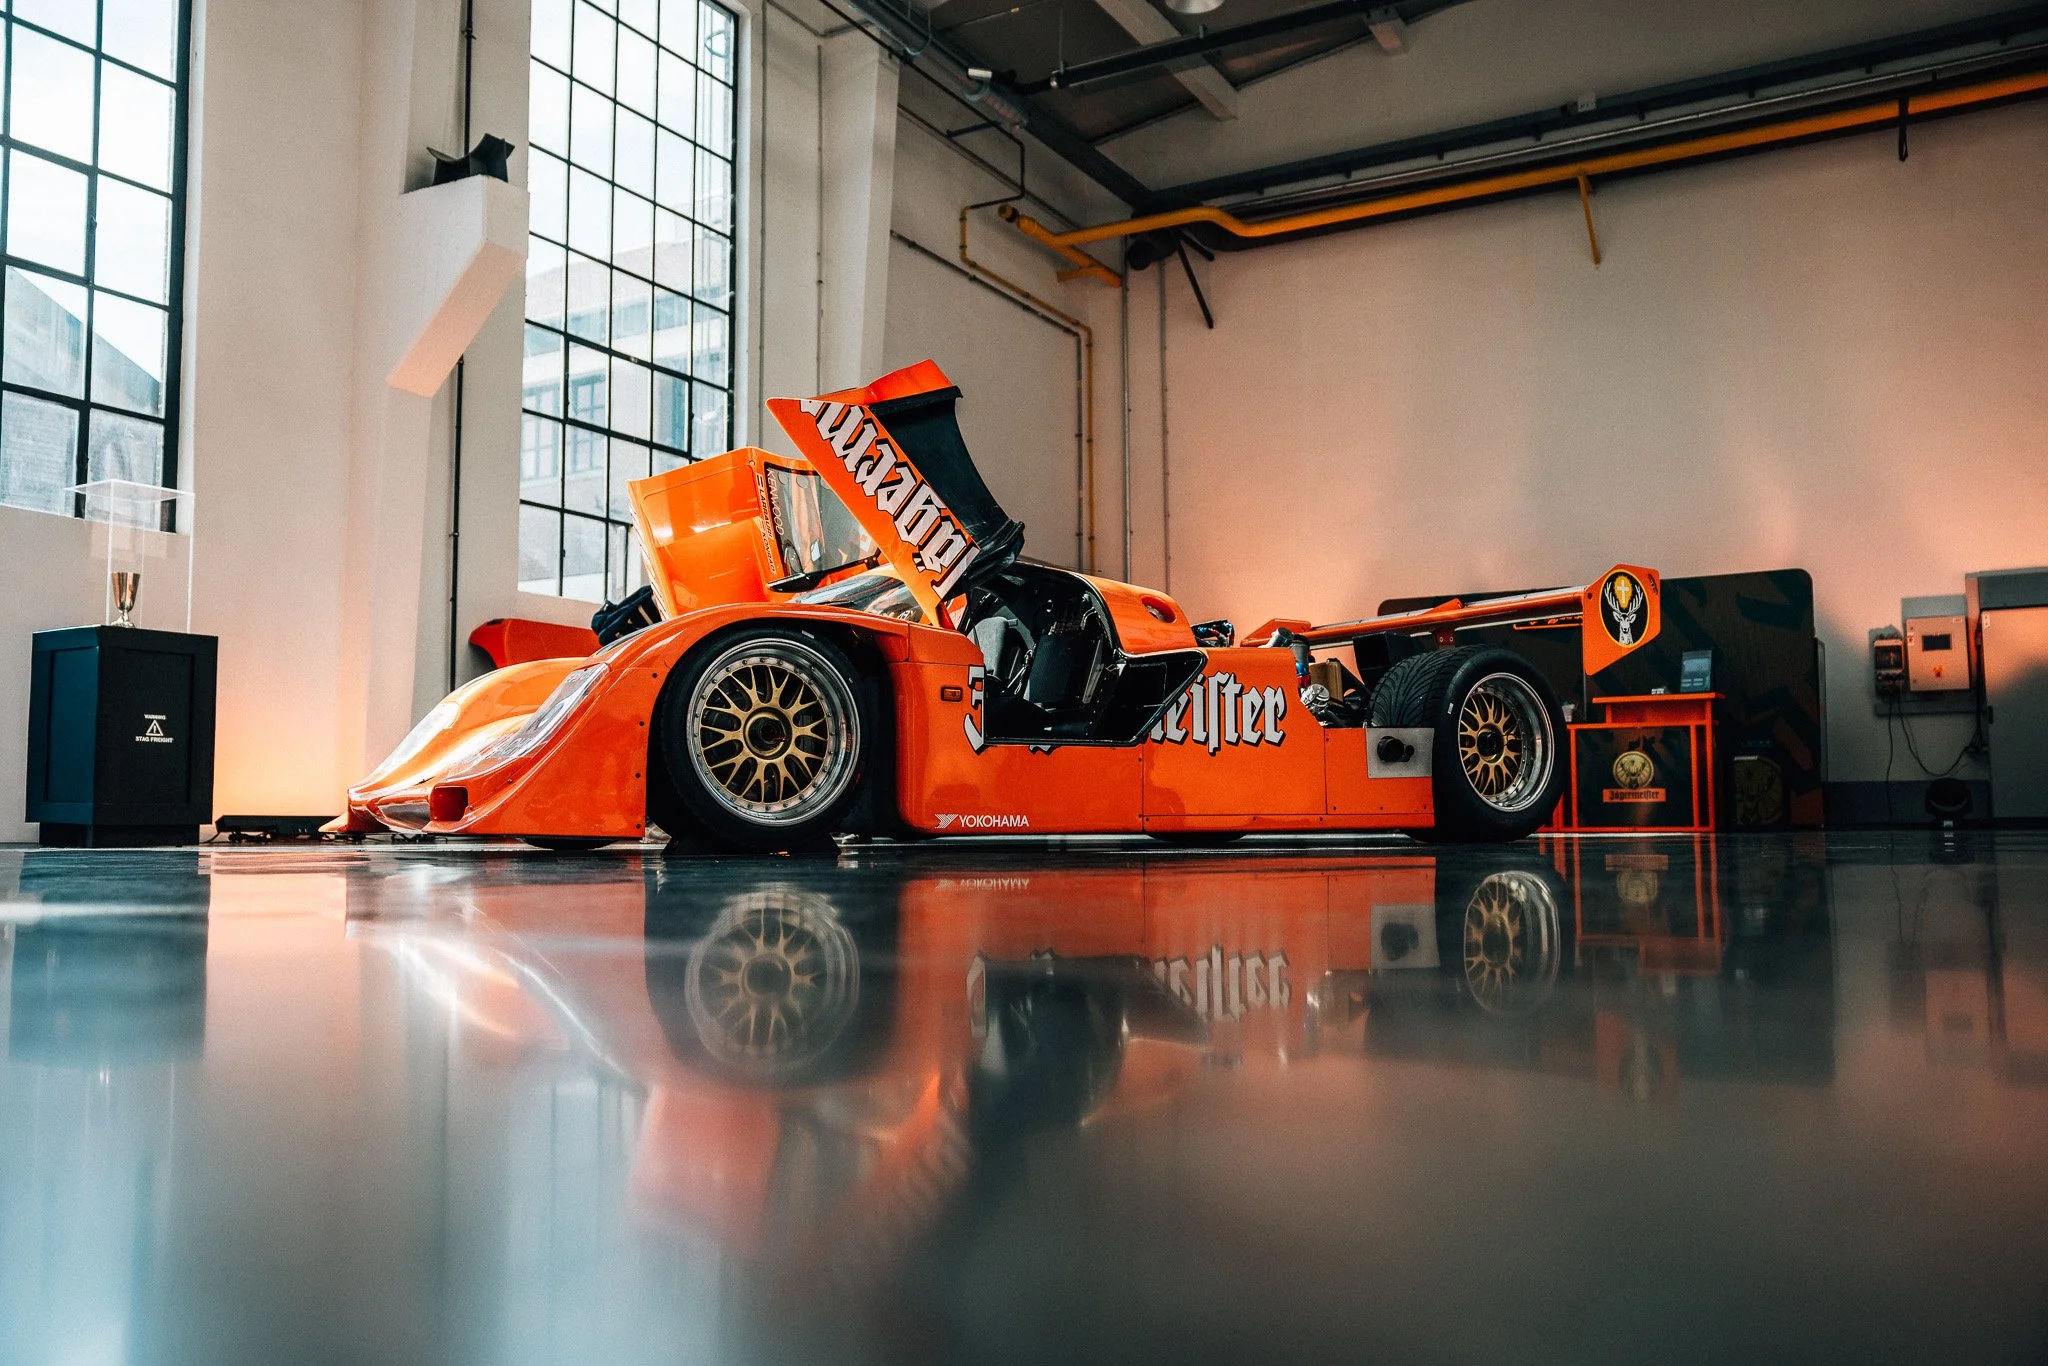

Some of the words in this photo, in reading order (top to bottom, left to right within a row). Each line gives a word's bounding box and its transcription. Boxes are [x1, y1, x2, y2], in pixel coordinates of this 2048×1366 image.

[759, 488, 773, 538] LARRAURI
[766, 467, 785, 536] KENWOOD
[761, 531, 776, 572] KONRAD
[959, 815, 1030, 828] YOKOHAMA
